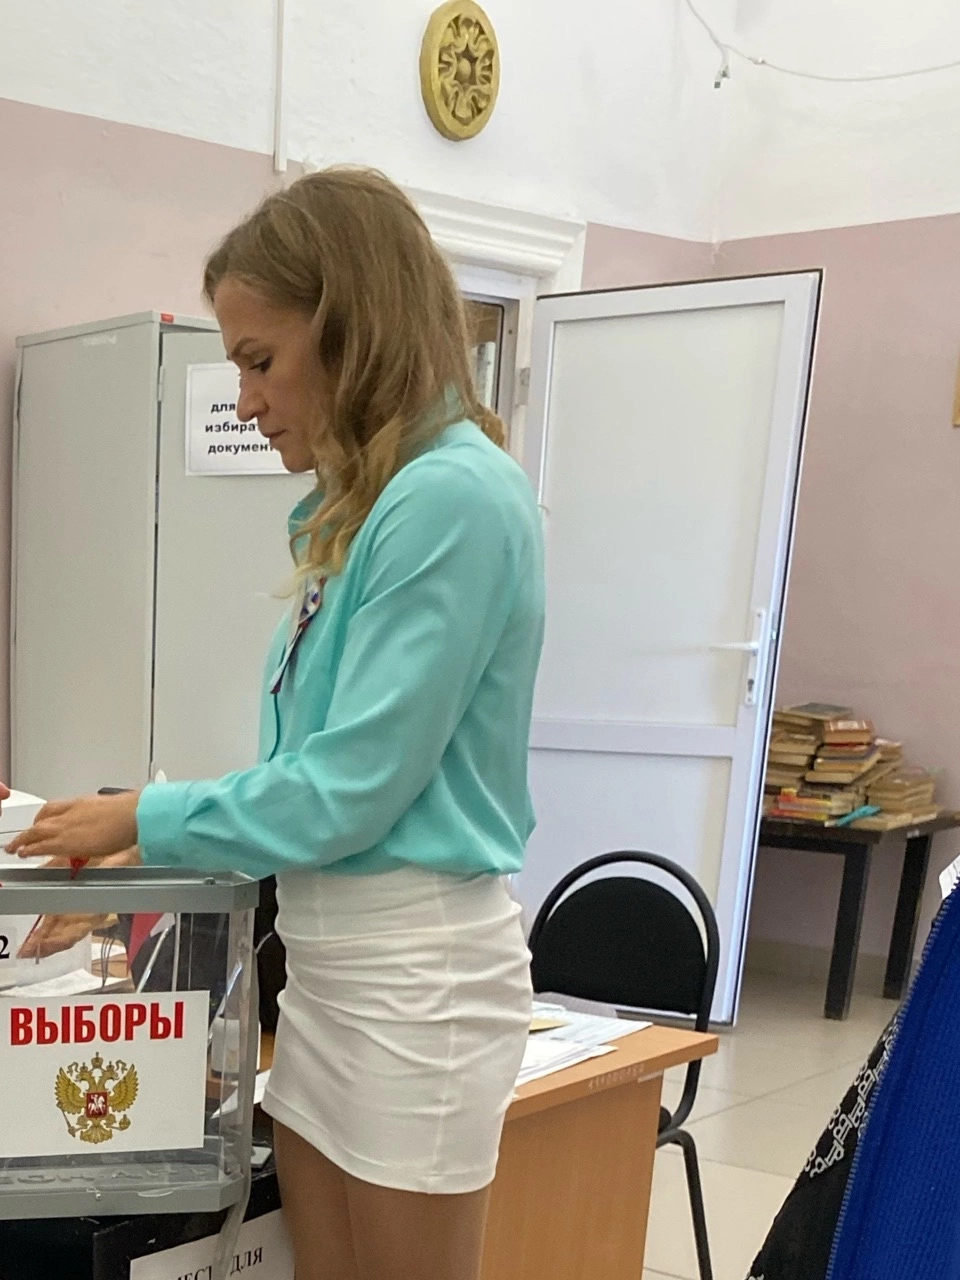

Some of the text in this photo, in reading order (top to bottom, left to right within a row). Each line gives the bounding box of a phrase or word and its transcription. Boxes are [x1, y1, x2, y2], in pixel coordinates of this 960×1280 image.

[211, 403, 236, 413] для
[205, 421, 259, 434] избира
[10, 1002, 184, 1046] ВЫБОРЫ
[230, 1246, 263, 1276] ДЛЯ
